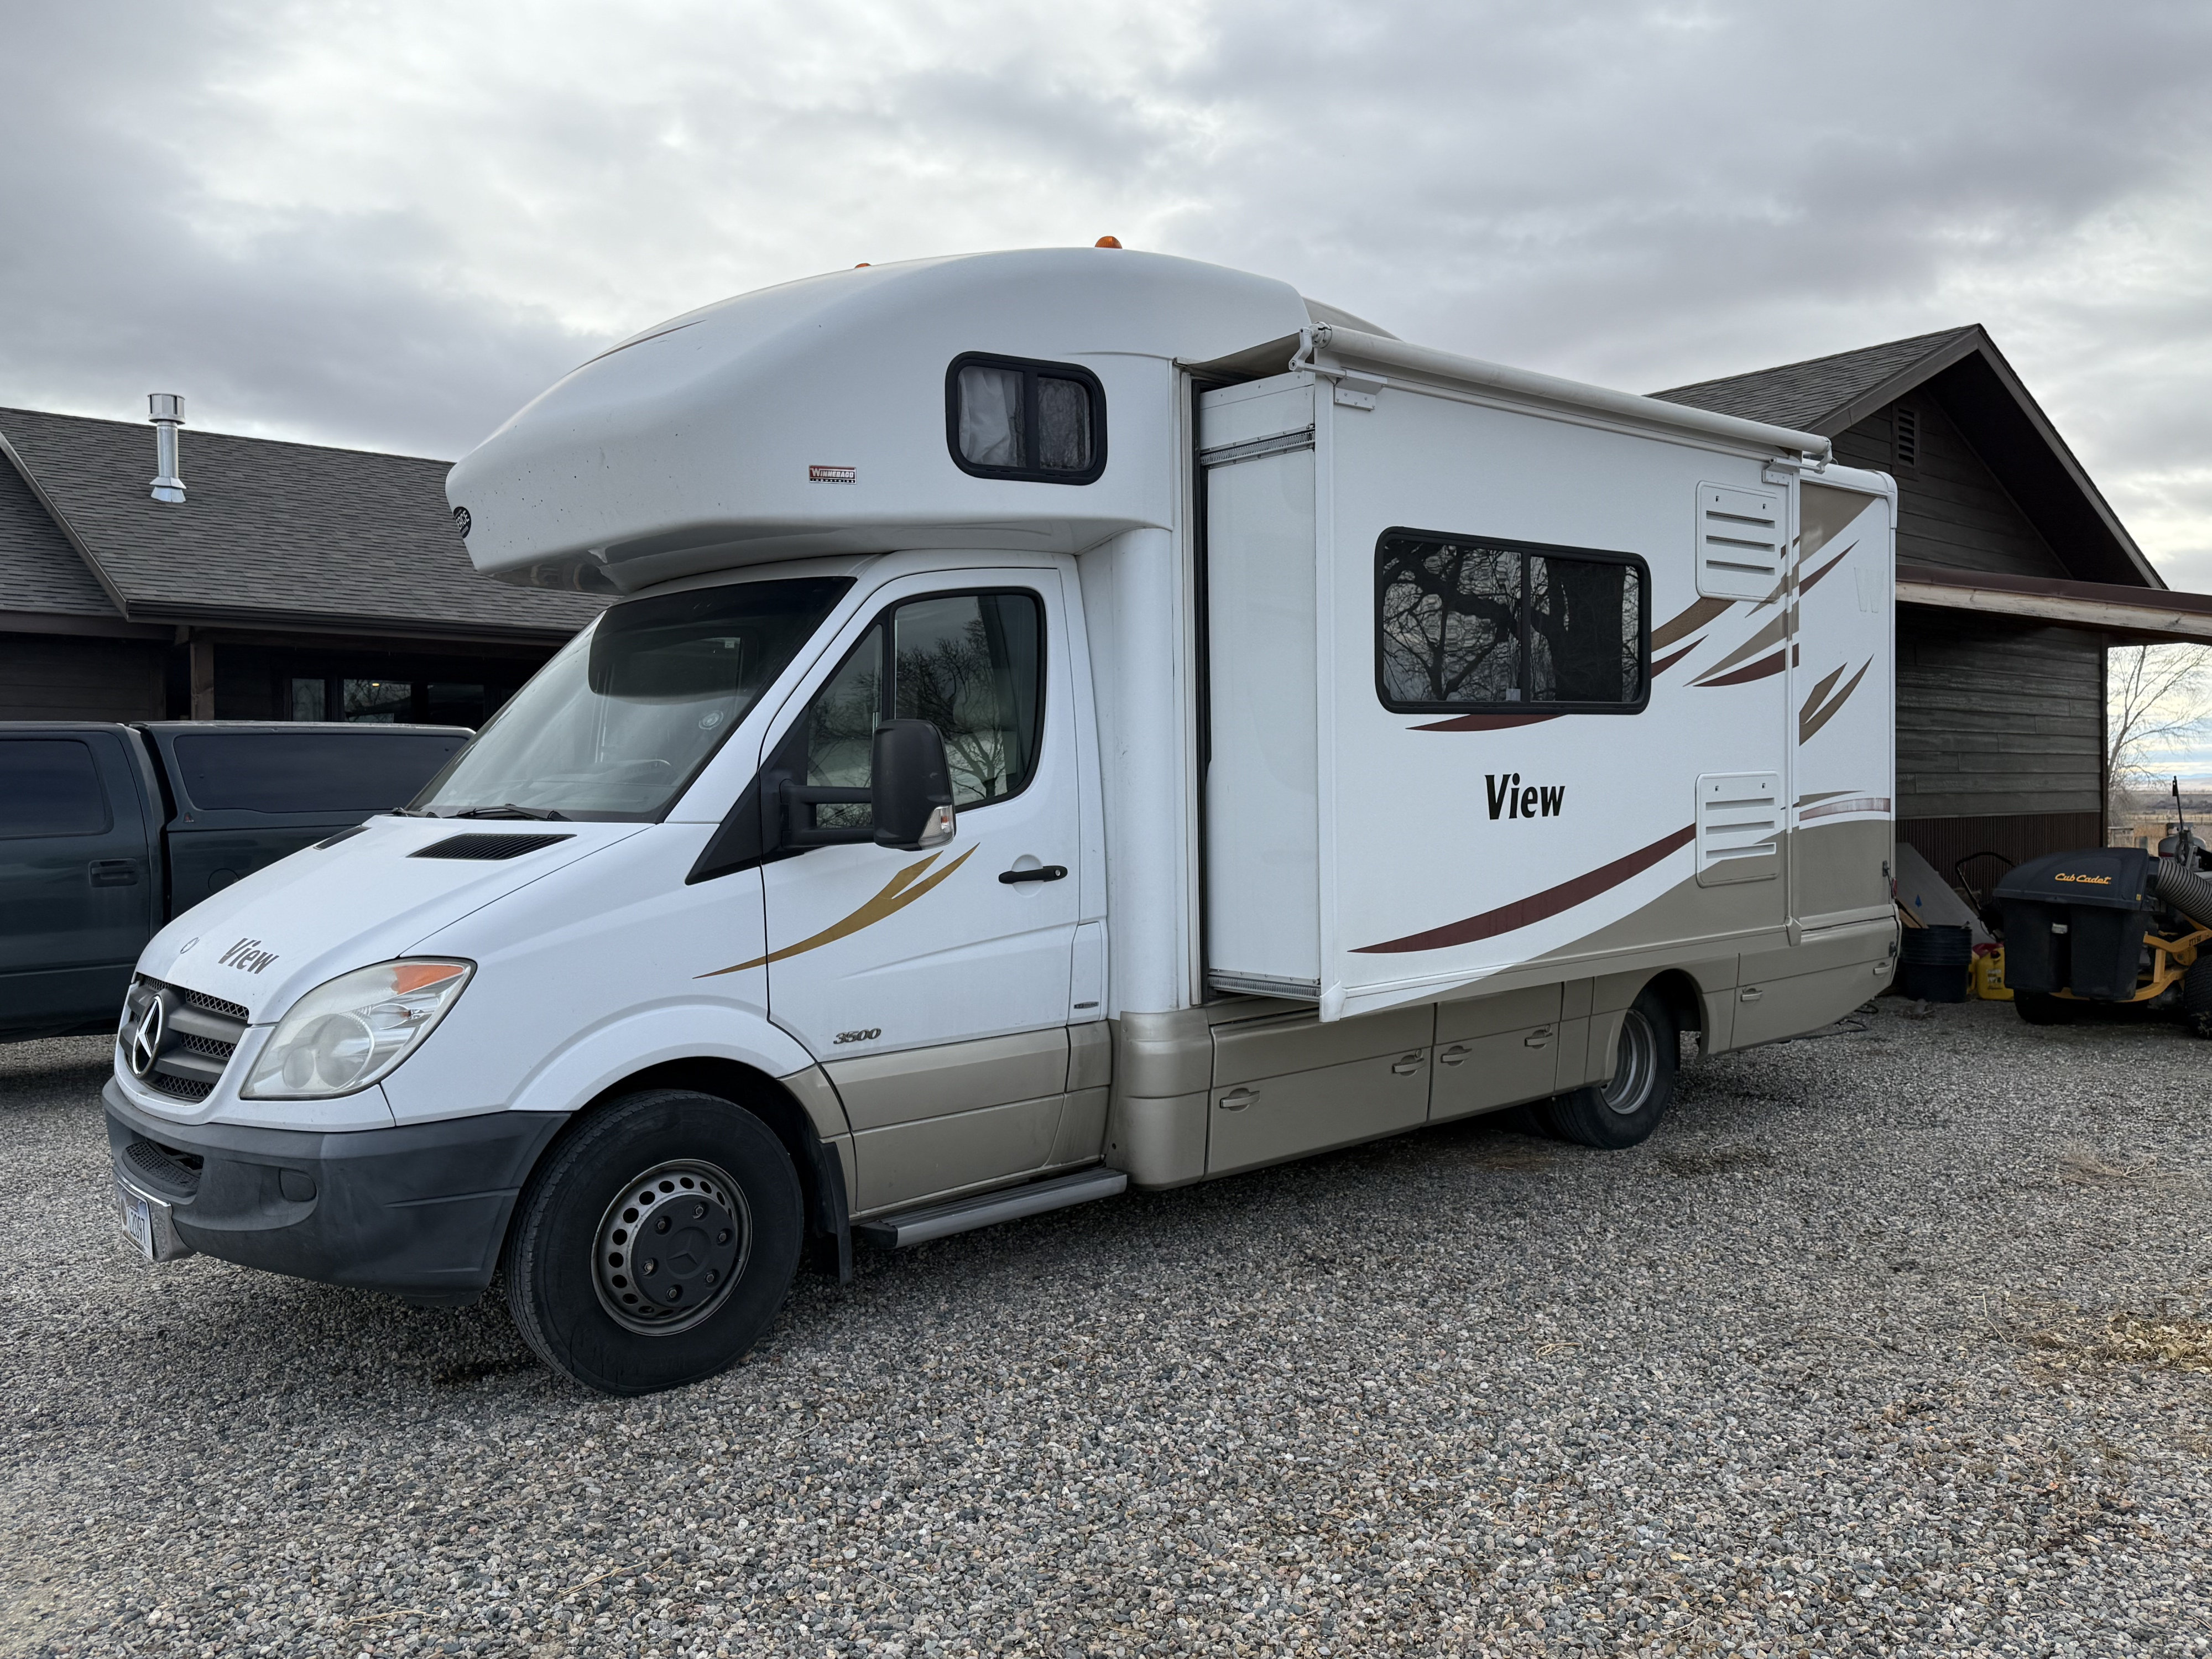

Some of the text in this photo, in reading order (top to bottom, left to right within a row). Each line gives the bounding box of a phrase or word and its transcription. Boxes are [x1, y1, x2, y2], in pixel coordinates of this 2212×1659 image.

[811, 468, 854, 478] WINNEBAGO
[1484, 773, 1566, 820] View
[2055, 873, 2111, 884] Cub Cadet
[218, 938, 279, 974] View
[833, 1027, 881, 1044] 3500
